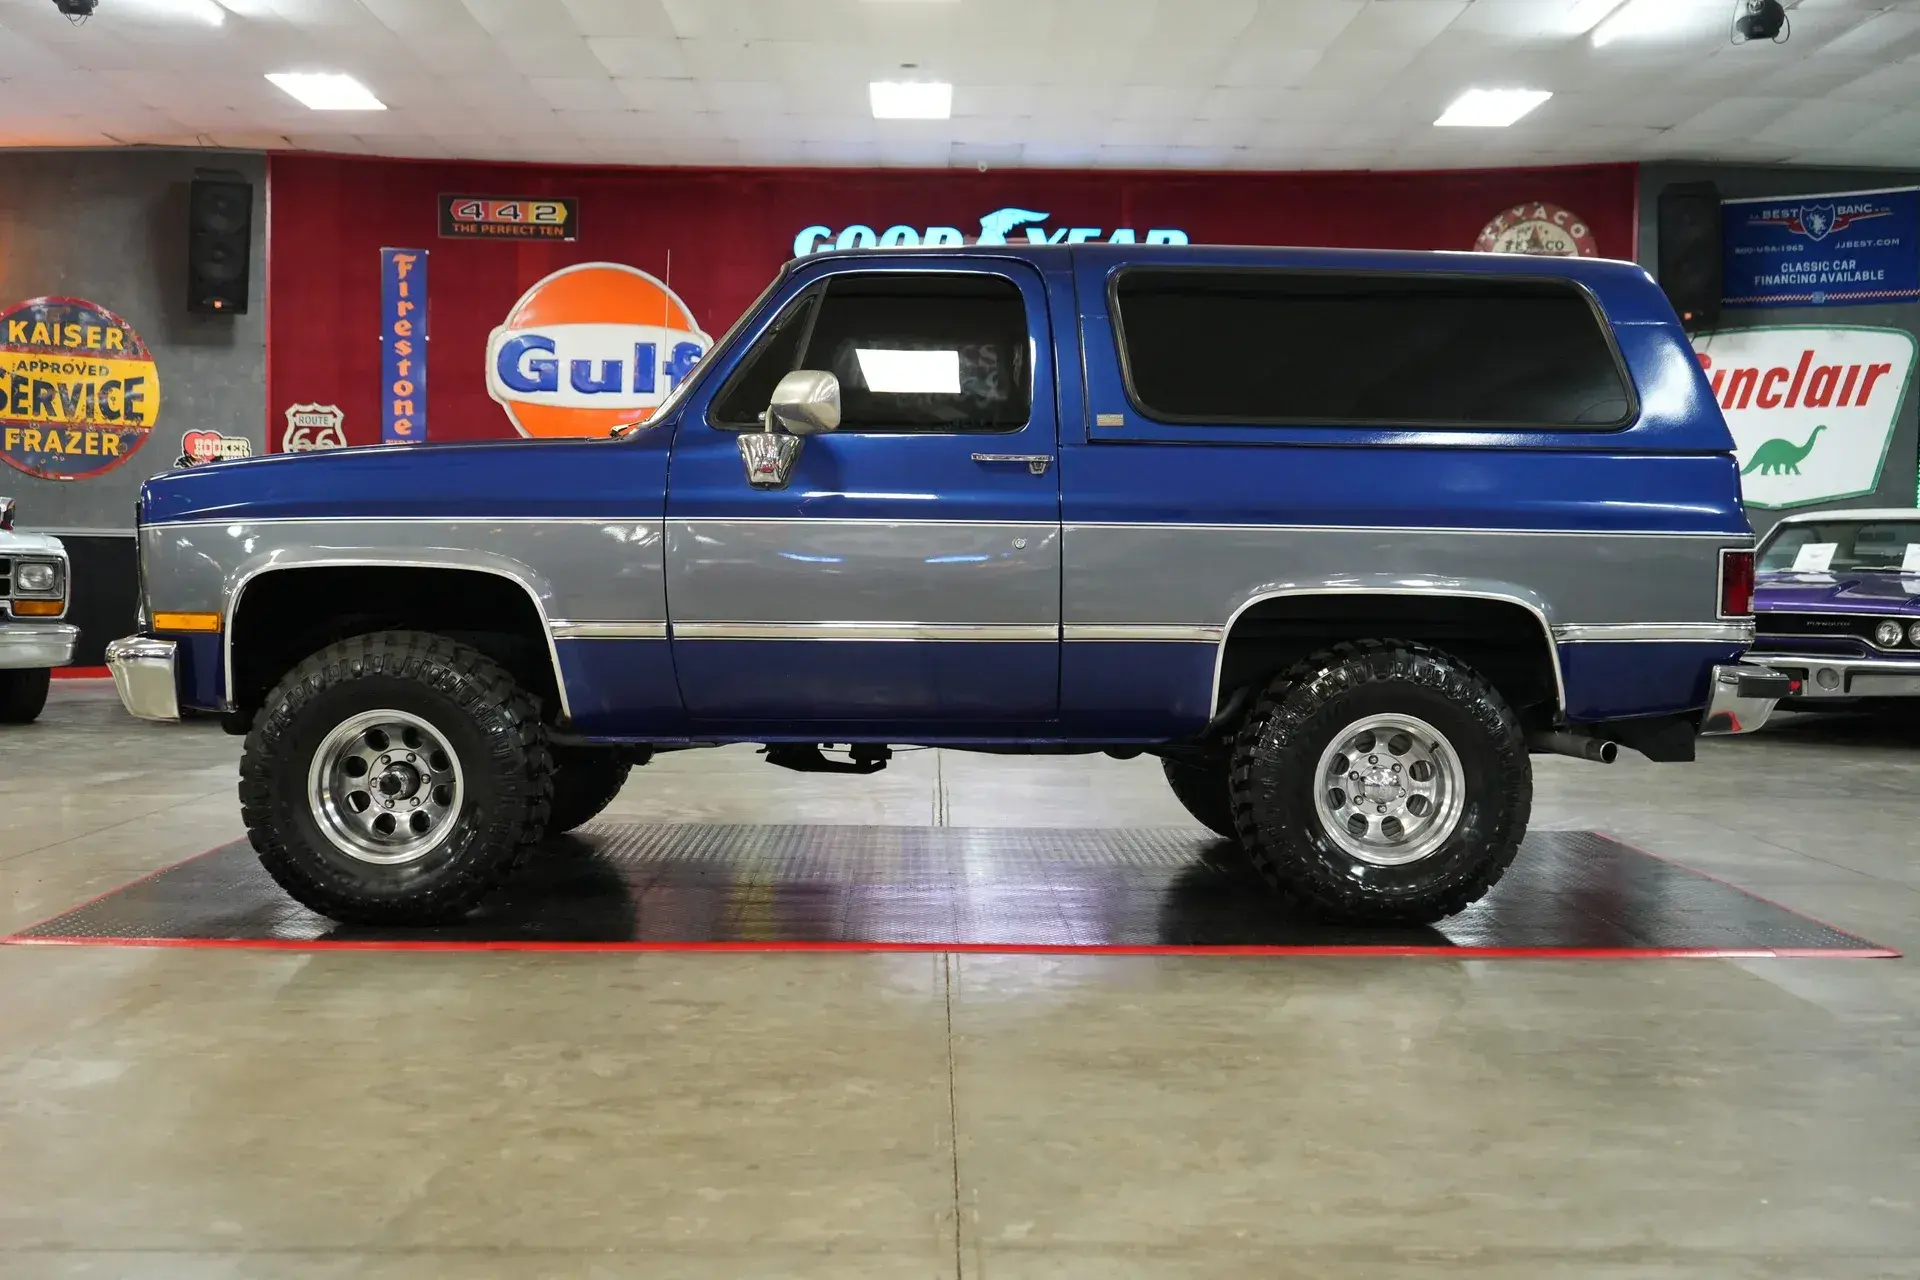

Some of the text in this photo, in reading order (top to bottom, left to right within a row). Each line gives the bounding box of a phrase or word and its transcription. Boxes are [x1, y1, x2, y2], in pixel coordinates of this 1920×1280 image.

[1762, 209, 1798, 219] BEST
[1838, 204, 1873, 215] BANC
[453, 223, 564, 235] THE PERFECT TEN
[1835, 238, 1900, 249] JJBEST.COM
[1781, 259, 1856, 273] CLASSIC CAR
[1754, 269, 1885, 286] FINANCING AVAILABLE
[8, 320, 124, 350] KAISER
[393, 253, 417, 435] Firestone
[16, 360, 110, 376] APPROVED
[497, 334, 703, 395] Gulf
[298, 415, 329, 425] ROUTE
[5, 427, 120, 456] FRAZER
[292, 428, 336, 451] 66
